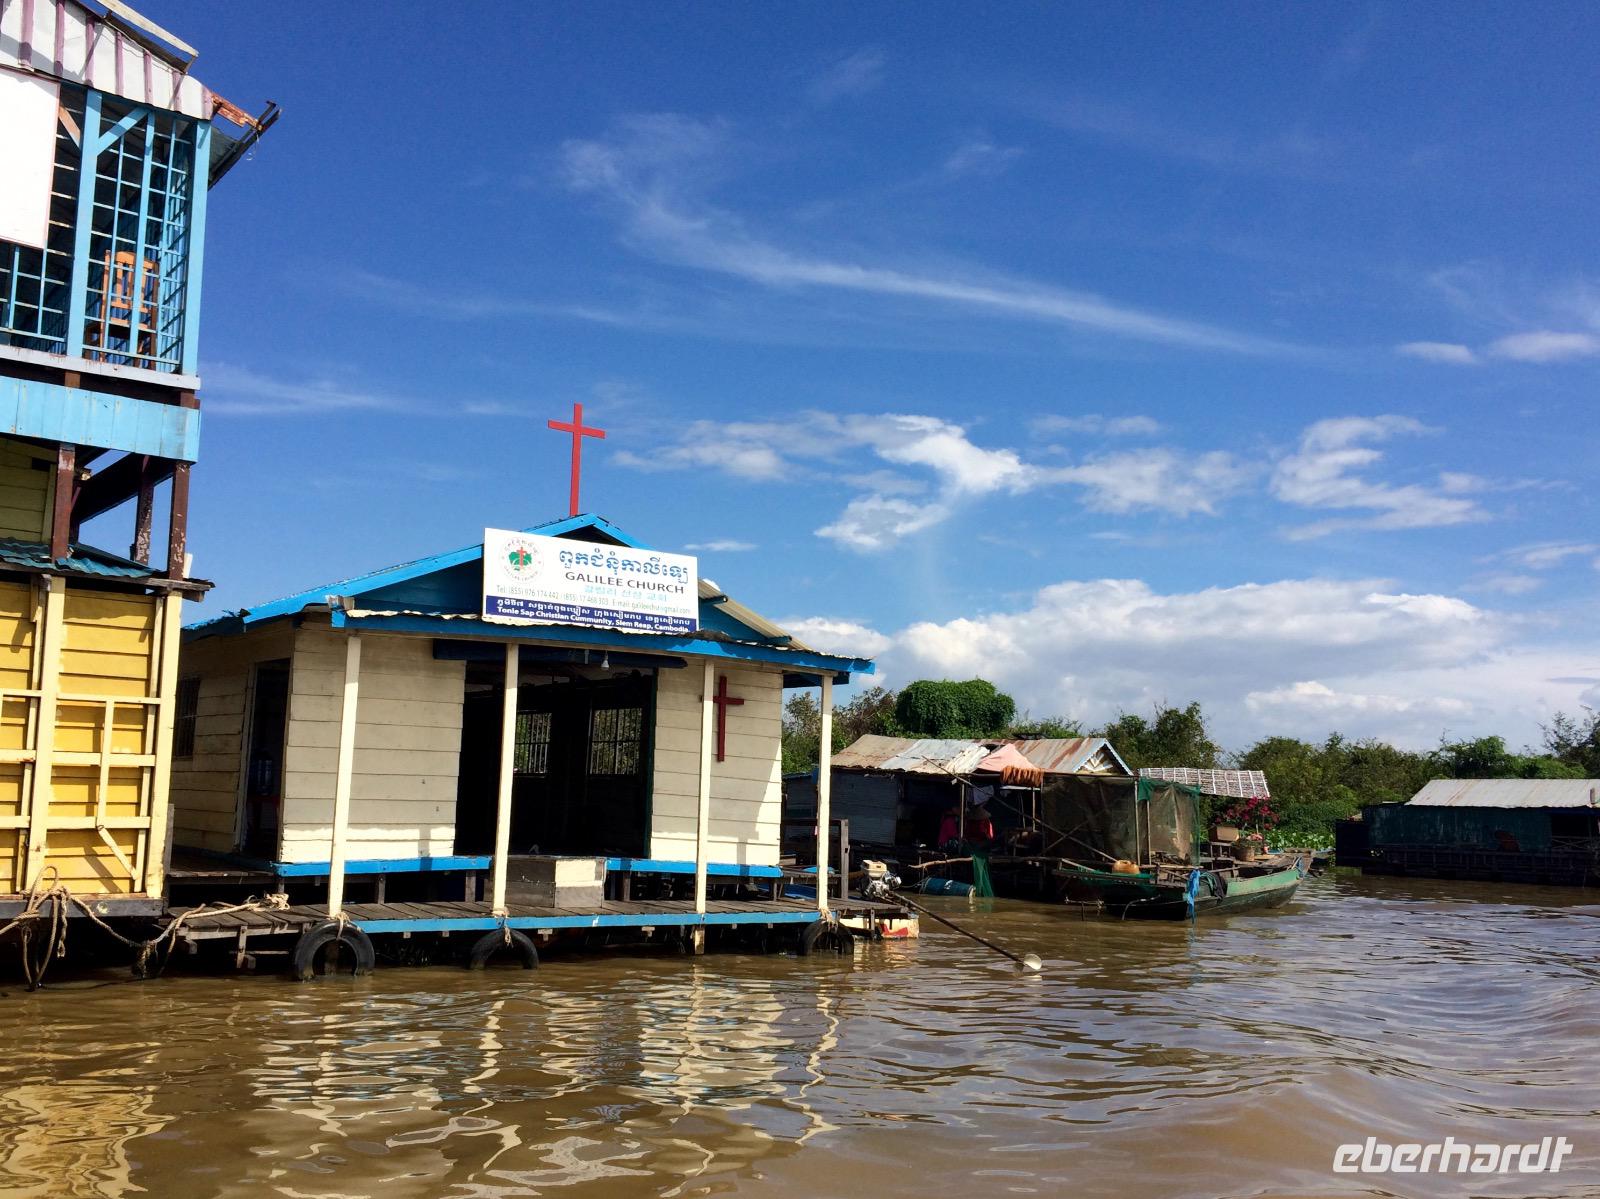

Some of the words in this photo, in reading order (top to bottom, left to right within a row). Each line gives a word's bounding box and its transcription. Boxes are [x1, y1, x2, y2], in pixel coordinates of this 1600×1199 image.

[565, 571, 624, 587] GALILEE
[627, 579, 684, 594] CHURCH
[497, 607, 519, 615] Tonle
[520, 609, 535, 617] Sap
[536, 611, 569, 620] Christian
[615, 619, 633, 627] Siem
